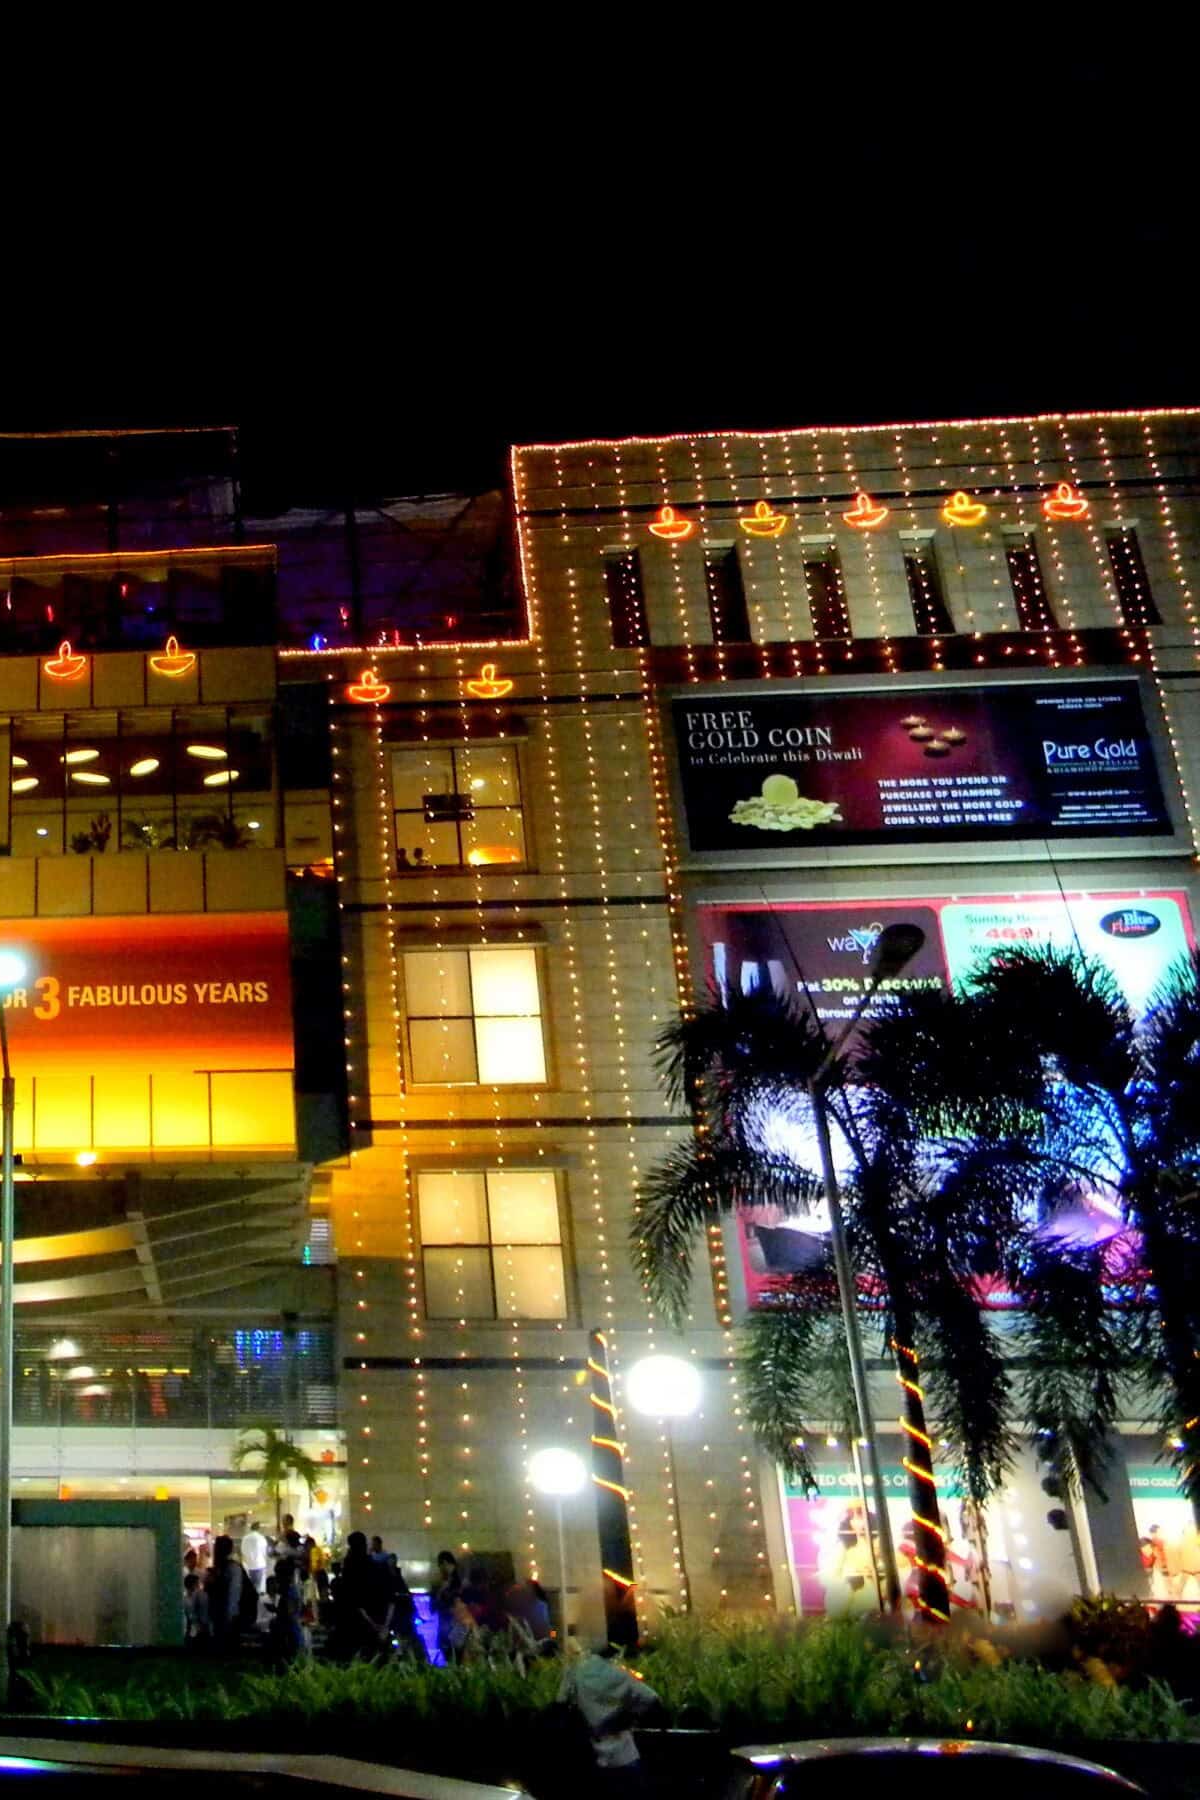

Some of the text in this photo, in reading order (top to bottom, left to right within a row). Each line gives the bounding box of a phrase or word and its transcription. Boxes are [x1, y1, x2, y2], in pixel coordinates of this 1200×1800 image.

[686, 710, 754, 730] FREE
[688, 727, 832, 749] GOLD COIN
[690, 747, 863, 766] to Celebrate this Diwali
[1042, 738, 1137, 765] Pure Gold
[878, 775, 1008, 788] THE MORE YOU SPEND ON
[880, 788, 1001, 800] PURCHASE OF DIAMOND
[883, 800, 1023, 812] JEWELLERY THE MORE GOLD
[884, 813, 1013, 825] COINS YOU GET FOR FREE
[1123, 910, 1155, 926] Blue
[822, 978, 860, 992] 30%
[32, 976, 61, 1021] 3
[67, 983, 188, 1007] FABULOUS
[194, 981, 269, 1004] YEARS
